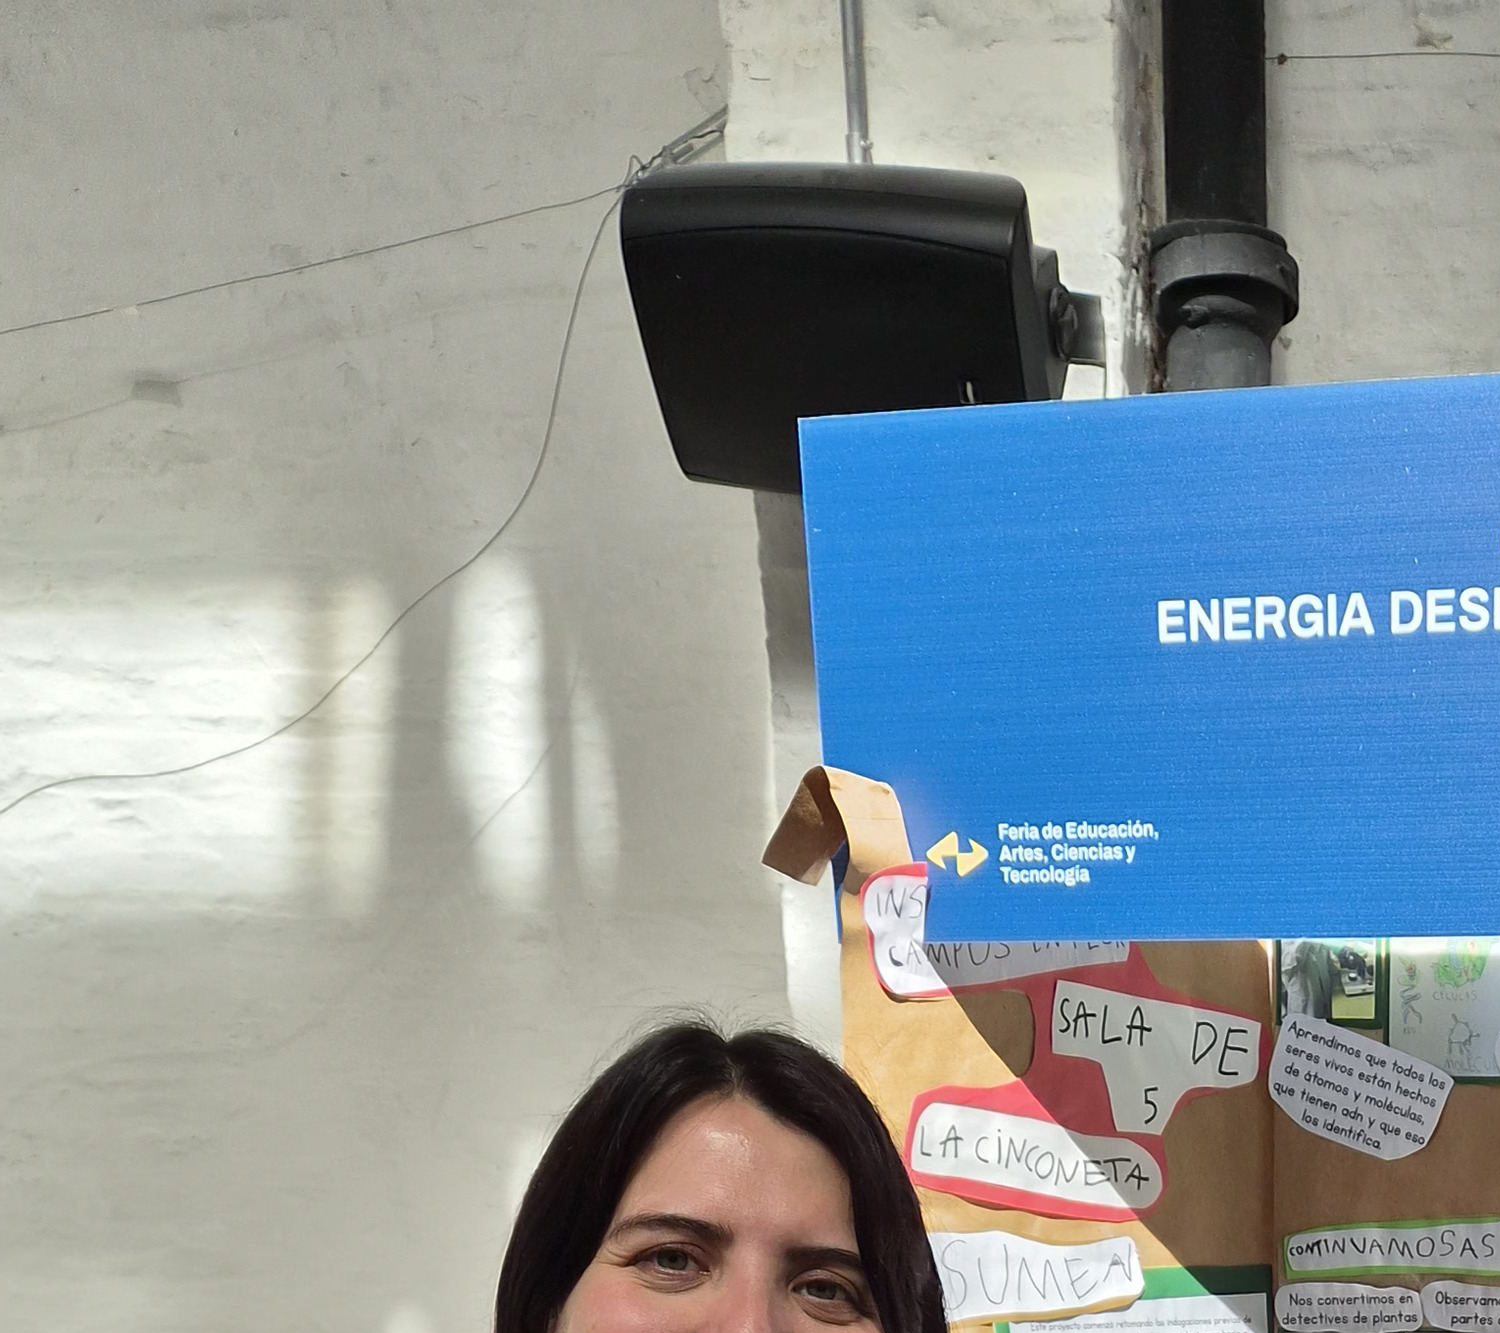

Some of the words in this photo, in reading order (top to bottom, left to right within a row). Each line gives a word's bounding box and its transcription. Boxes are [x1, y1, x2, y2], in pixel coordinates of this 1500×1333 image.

[1157, 592, 1376, 645] ENERGIA
[998, 822, 1039, 841] Feria
[1042, 822, 1062, 840] de
[1065, 820, 1159, 840] Educación,
[999, 845, 1049, 864] Artes,
[1051, 843, 1121, 860] Ciencias
[1121, 845, 1136, 863] y
[1000, 865, 1090, 887] Tecnología
[1058, 997, 1152, 1048] SALA
[1191, 1020, 1249, 1076] DE
[1288, 1021, 1361, 1058] Aprendimos
[1365, 1052, 1387, 1068] que
[1392, 1060, 1424, 1083] todos
[1428, 1073, 1446, 1090] los
[1285, 1044, 1320, 1064] seres
[1324, 1058, 1354, 1076] vivos
[1358, 1070, 1392, 1091] están
[1395, 1080, 1437, 1107] hechos
[1285, 1062, 1300, 1077] de
[1304, 1070, 1349, 1096] átomos
[1354, 1090, 1361, 1101] y
[1365, 1094, 1424, 1125] moléculas,
[1143, 1086, 1159, 1124] 5
[1273, 1081, 1295, 1097] que
[1300, 1088, 1337, 1112] tienen
[1342, 1105, 1364, 1122] adn
[1368, 1117, 1375, 1128] y
[1380, 1121, 1401, 1136] que
[1405, 1131, 1426, 1145] eso
[919, 1125, 963, 1158] LA
[1302, 1109, 1319, 1126] los
[1323, 1119, 1382, 1150] identifica.
[1289, 1293, 1313, 1307] Nos
[1317, 1292, 1395, 1307] convertimos
[1399, 1294, 1414, 1305] en
[1281, 1311, 1350, 1326] detectives
[1354, 1311, 1368, 1325] de
[1372, 1311, 1418, 1328] plantas
[1450, 1313, 1492, 1329] partes
